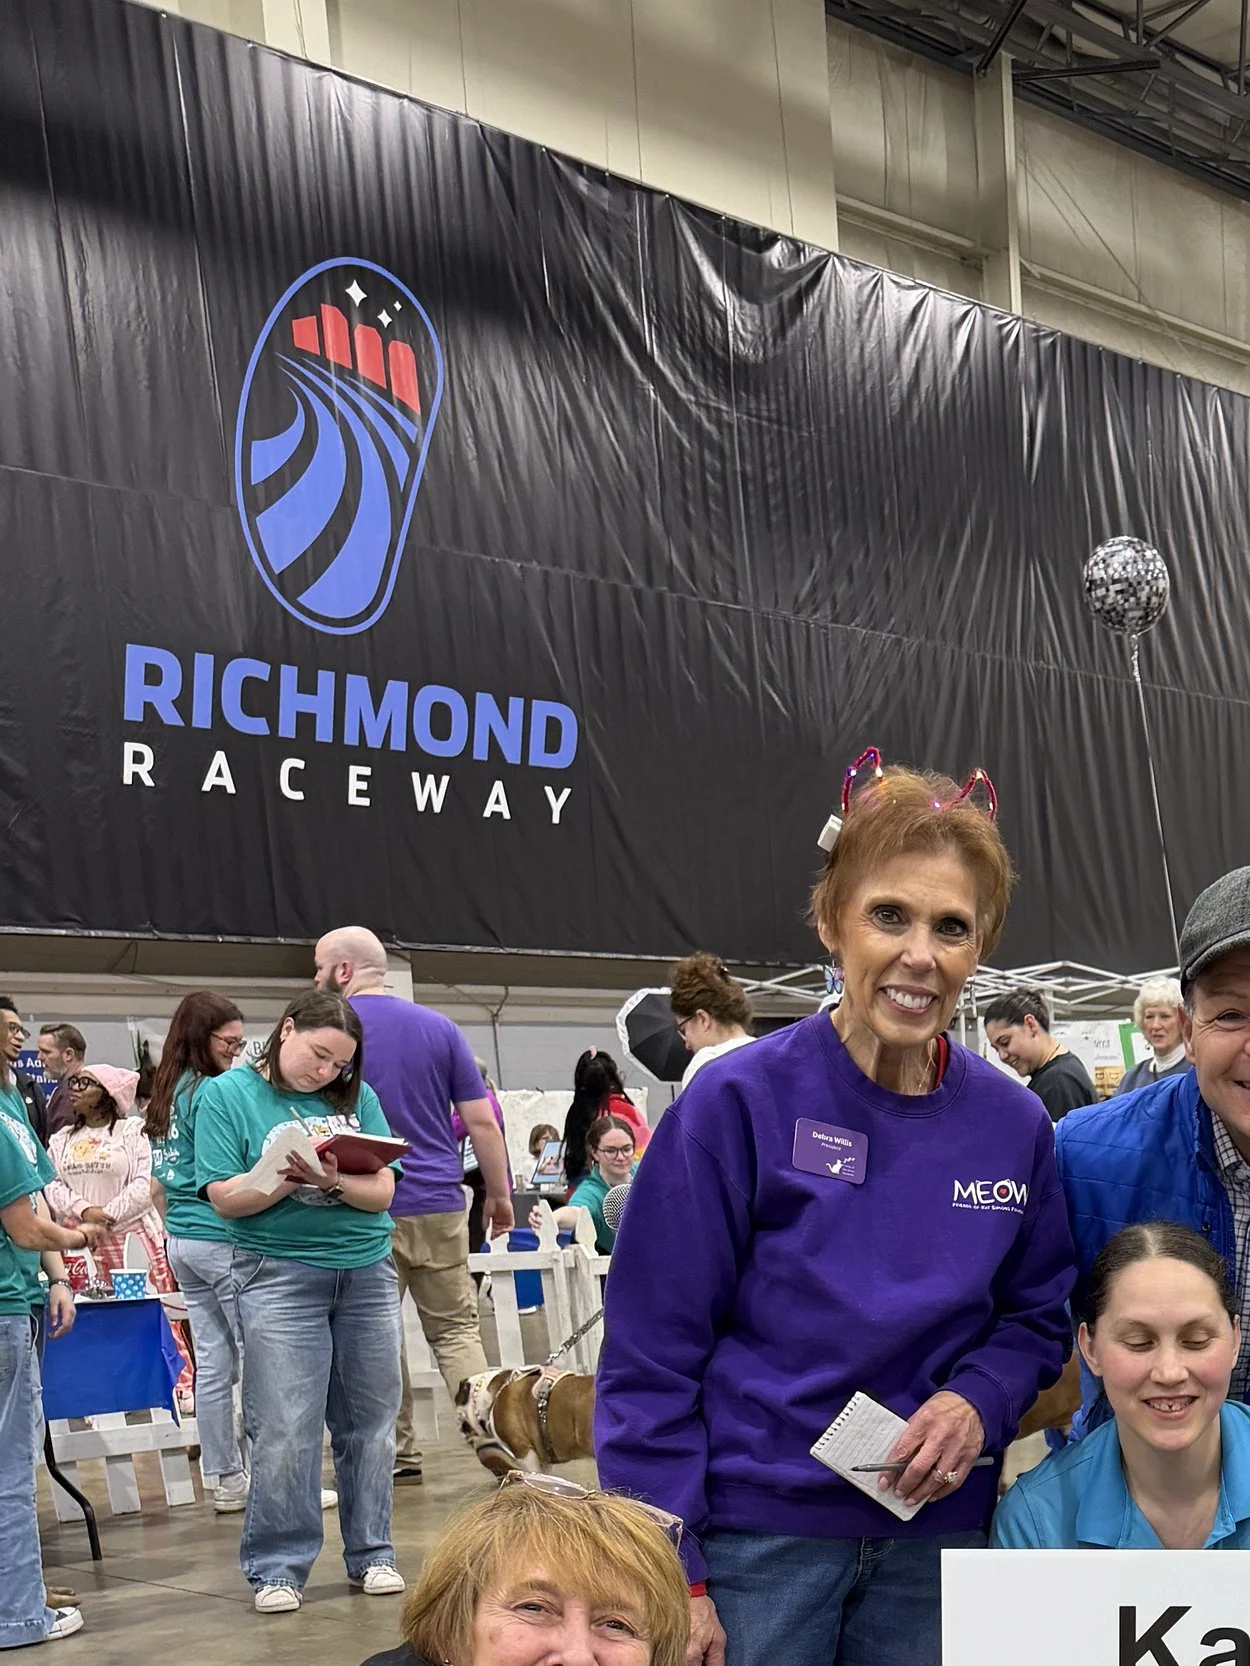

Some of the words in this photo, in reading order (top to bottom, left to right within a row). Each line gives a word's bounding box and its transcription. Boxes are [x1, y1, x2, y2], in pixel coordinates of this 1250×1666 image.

[123, 643, 579, 769] RICHMOND
[122, 742, 572, 824] RACEWAY
[812, 1131, 833, 1143] Debra
[834, 1136, 852, 1147] Willis
[953, 1178, 1028, 1206] MEOW
